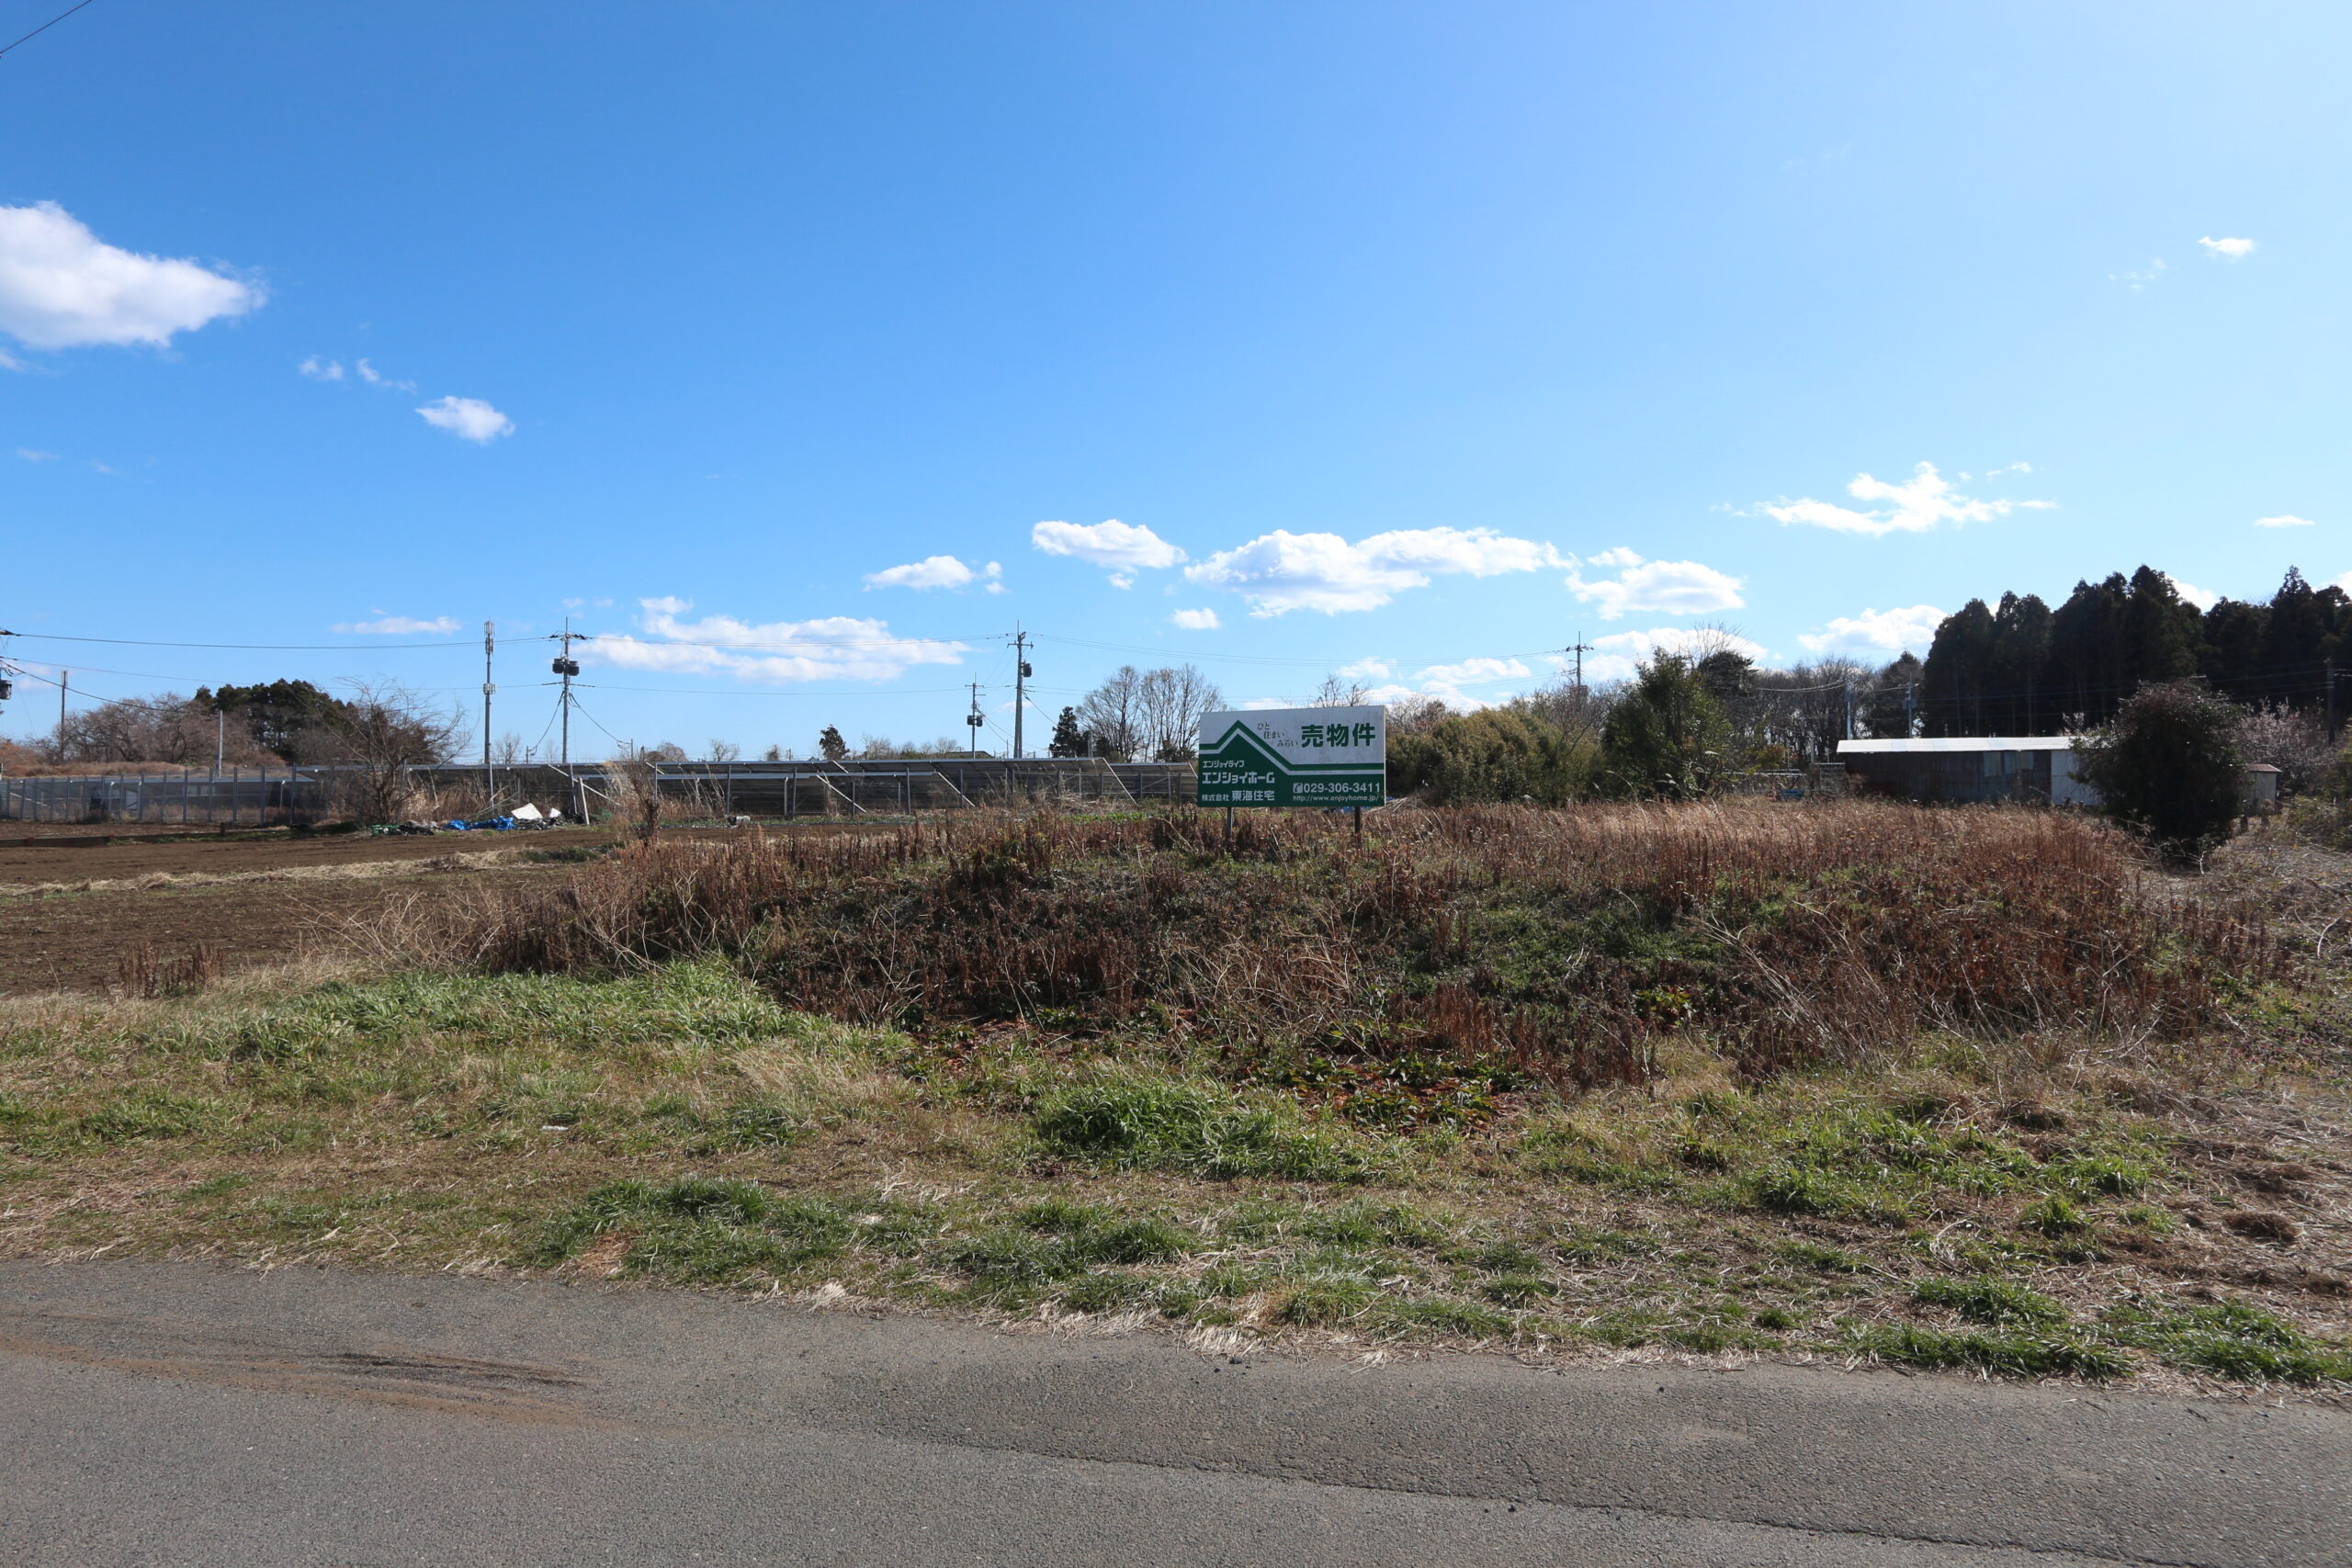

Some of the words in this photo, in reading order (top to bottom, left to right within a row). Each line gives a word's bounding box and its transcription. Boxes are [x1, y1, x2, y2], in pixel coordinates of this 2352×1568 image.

[1263, 730, 1284, 739] 住まい
[1301, 722, 1375, 748] 売物件
[1277, 739, 1298, 748] みらい
[1203, 760, 1245, 768] エンジョイライフ
[1202, 772, 1275, 784] エンジョイホーム
[1304, 783, 1380, 793] 029-306-3411
[1231, 790, 1275, 801] 東海住宅
